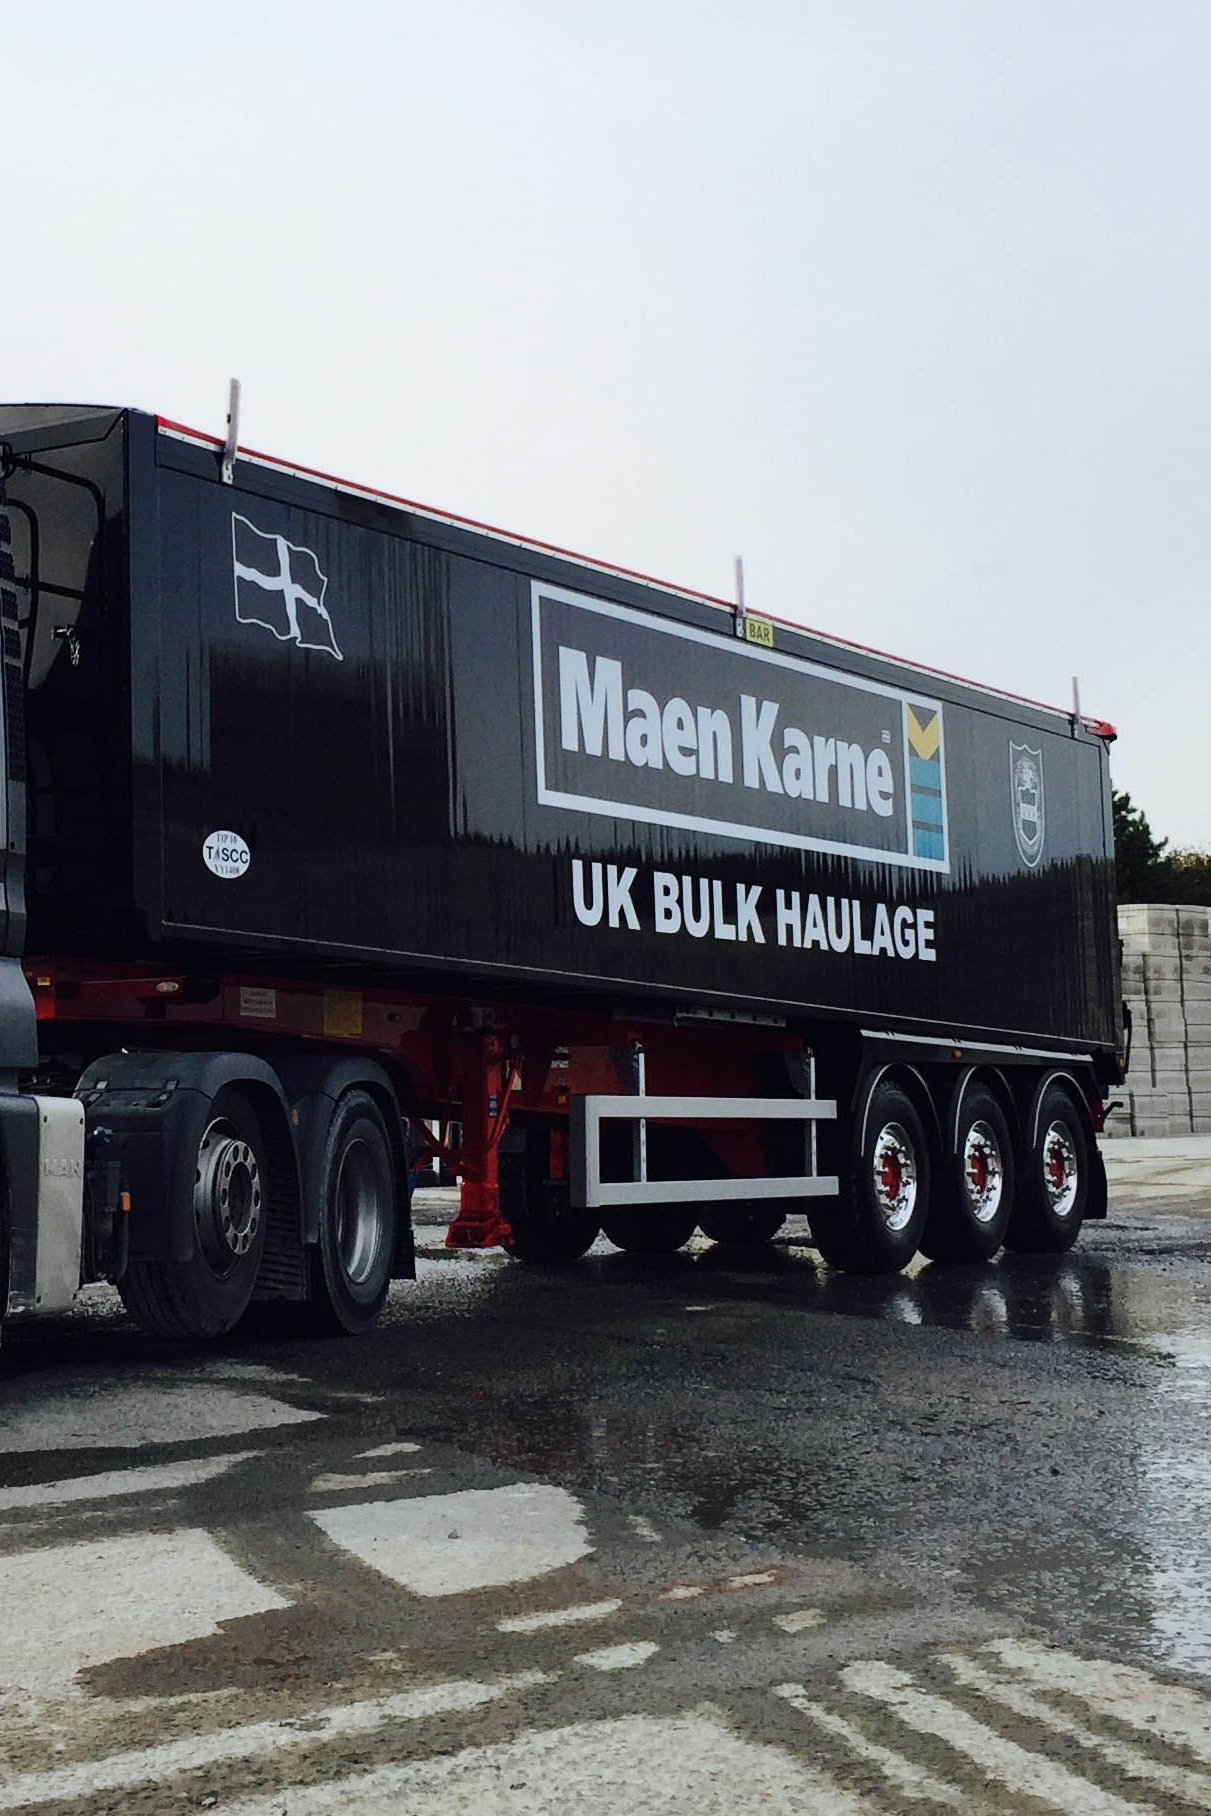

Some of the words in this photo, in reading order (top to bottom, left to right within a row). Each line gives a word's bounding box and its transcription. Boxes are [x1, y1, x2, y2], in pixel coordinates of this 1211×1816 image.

[749, 623, 770, 643] BAR
[558, 645, 734, 784] Maen
[740, 694, 894, 818] Karne
[572, 858, 641, 931] UK
[654, 871, 766, 944] BULK
[776, 888, 936, 962] HAULAGE
